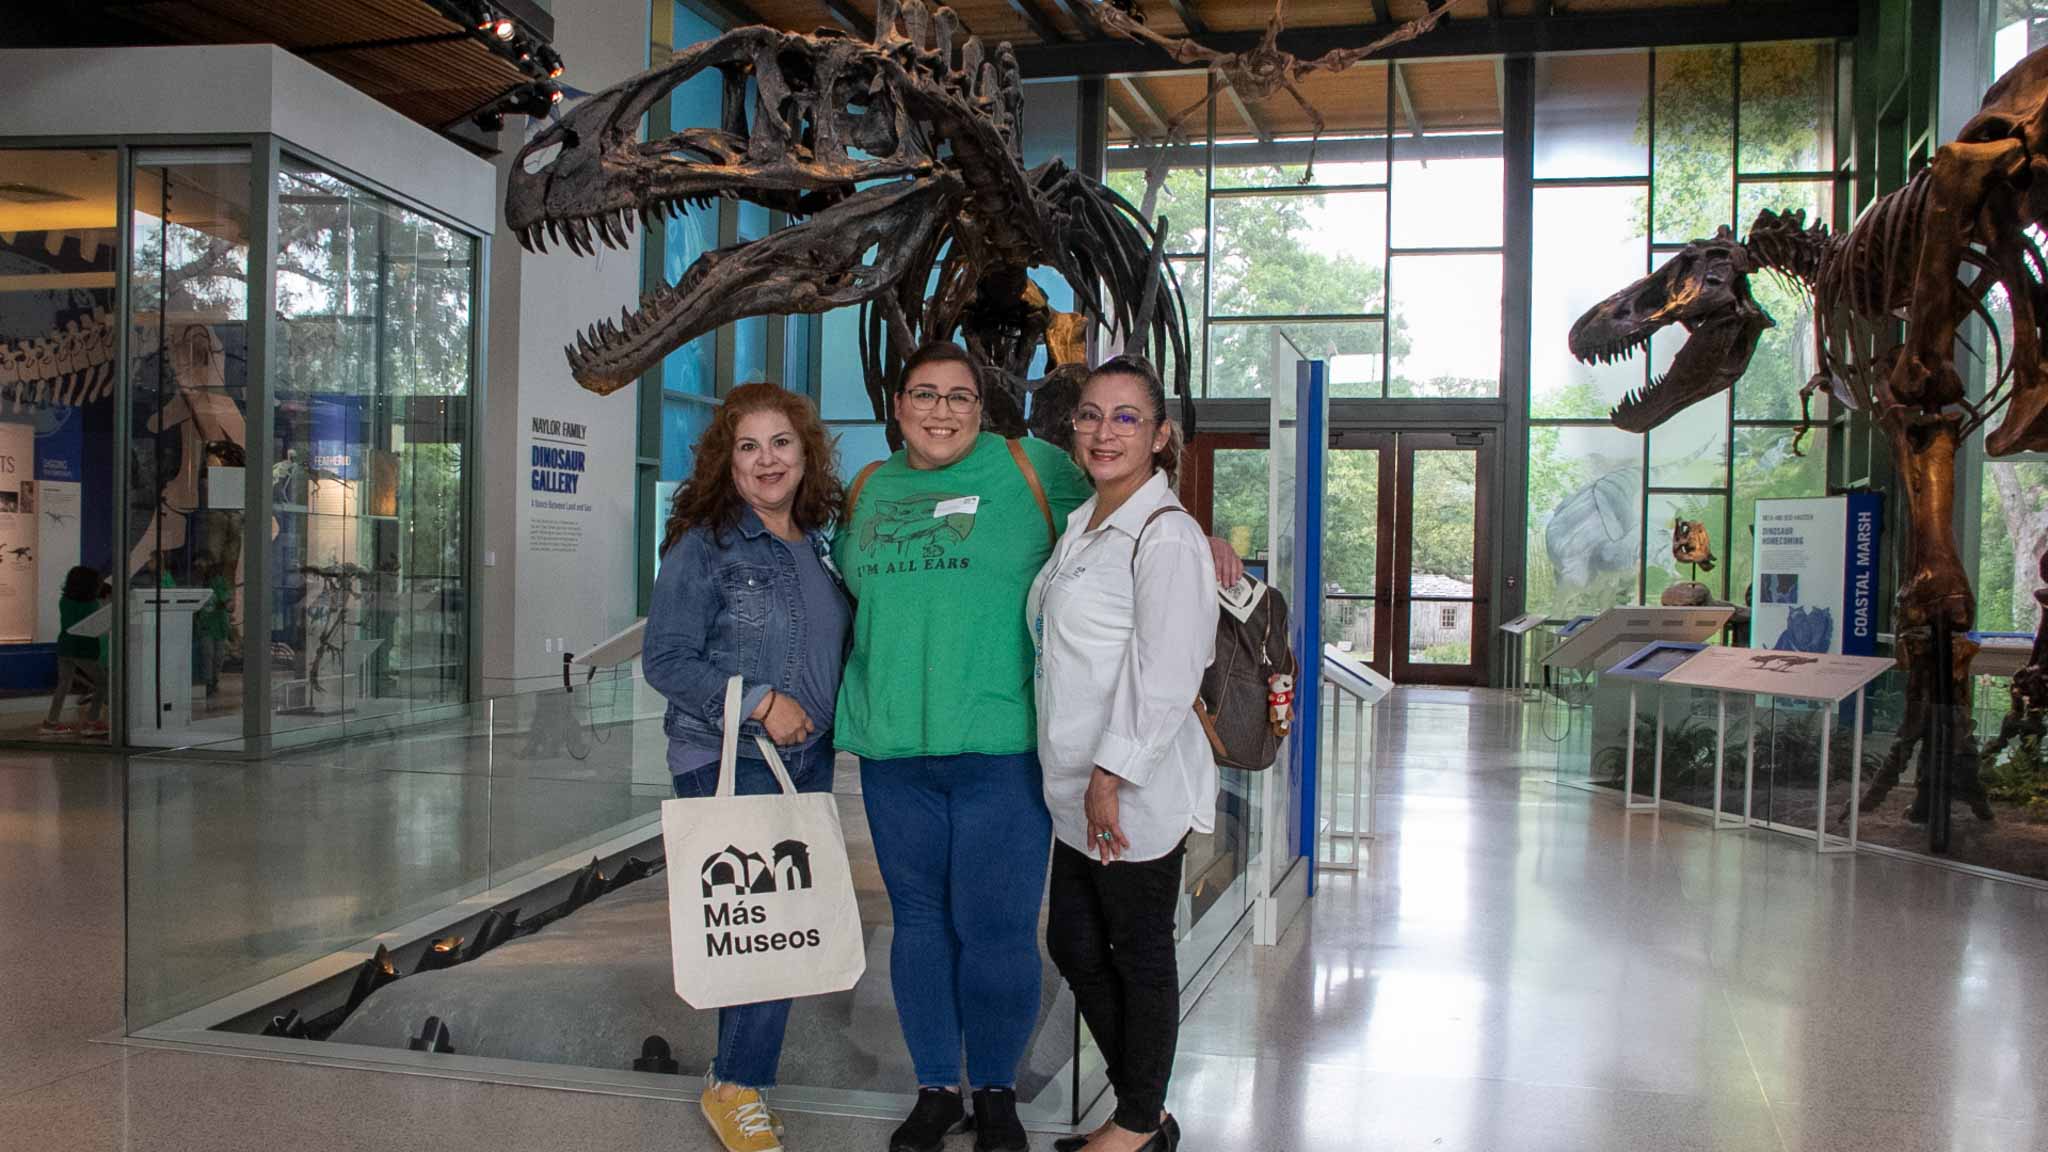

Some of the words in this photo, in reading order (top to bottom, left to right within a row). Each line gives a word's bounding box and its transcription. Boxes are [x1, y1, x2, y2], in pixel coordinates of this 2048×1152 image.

[532, 417, 561, 436] NAYLOR
[562, 421, 587, 440] FAMILY
[531, 445, 586, 472] DINOSAUR
[531, 469, 579, 494] GALLERY
[1856, 511, 1872, 566] MARSH
[857, 563, 879, 578] I'M
[886, 560, 917, 574] ALL
[923, 557, 971, 571] EARS
[1854, 571, 1870, 637] COASTAL
[703, 900, 767, 928] Más
[706, 928, 821, 958] Museos
